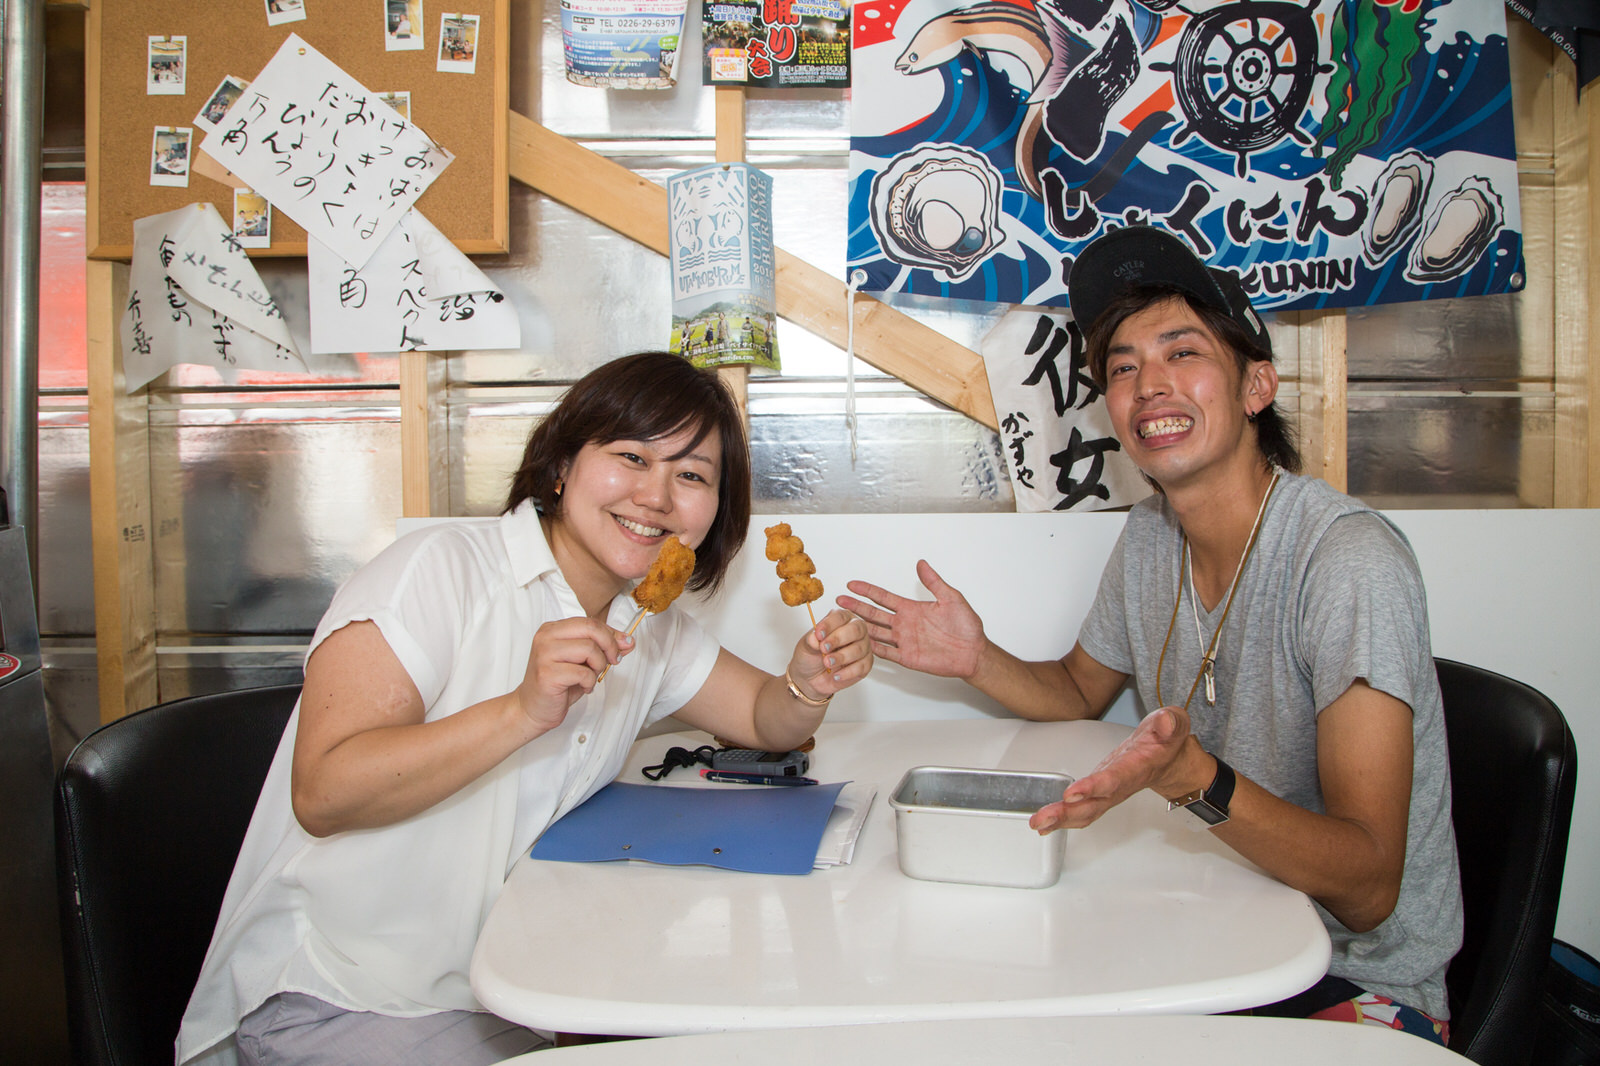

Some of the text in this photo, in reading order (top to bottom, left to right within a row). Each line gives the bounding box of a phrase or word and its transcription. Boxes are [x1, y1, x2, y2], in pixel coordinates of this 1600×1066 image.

[600, 19, 676, 27] TEL 0226-29-6379
[747, 38, 773, 77] 大会
[1113, 260, 1145, 278] CAYLER
[1001, 411, 1035, 490] かずや
